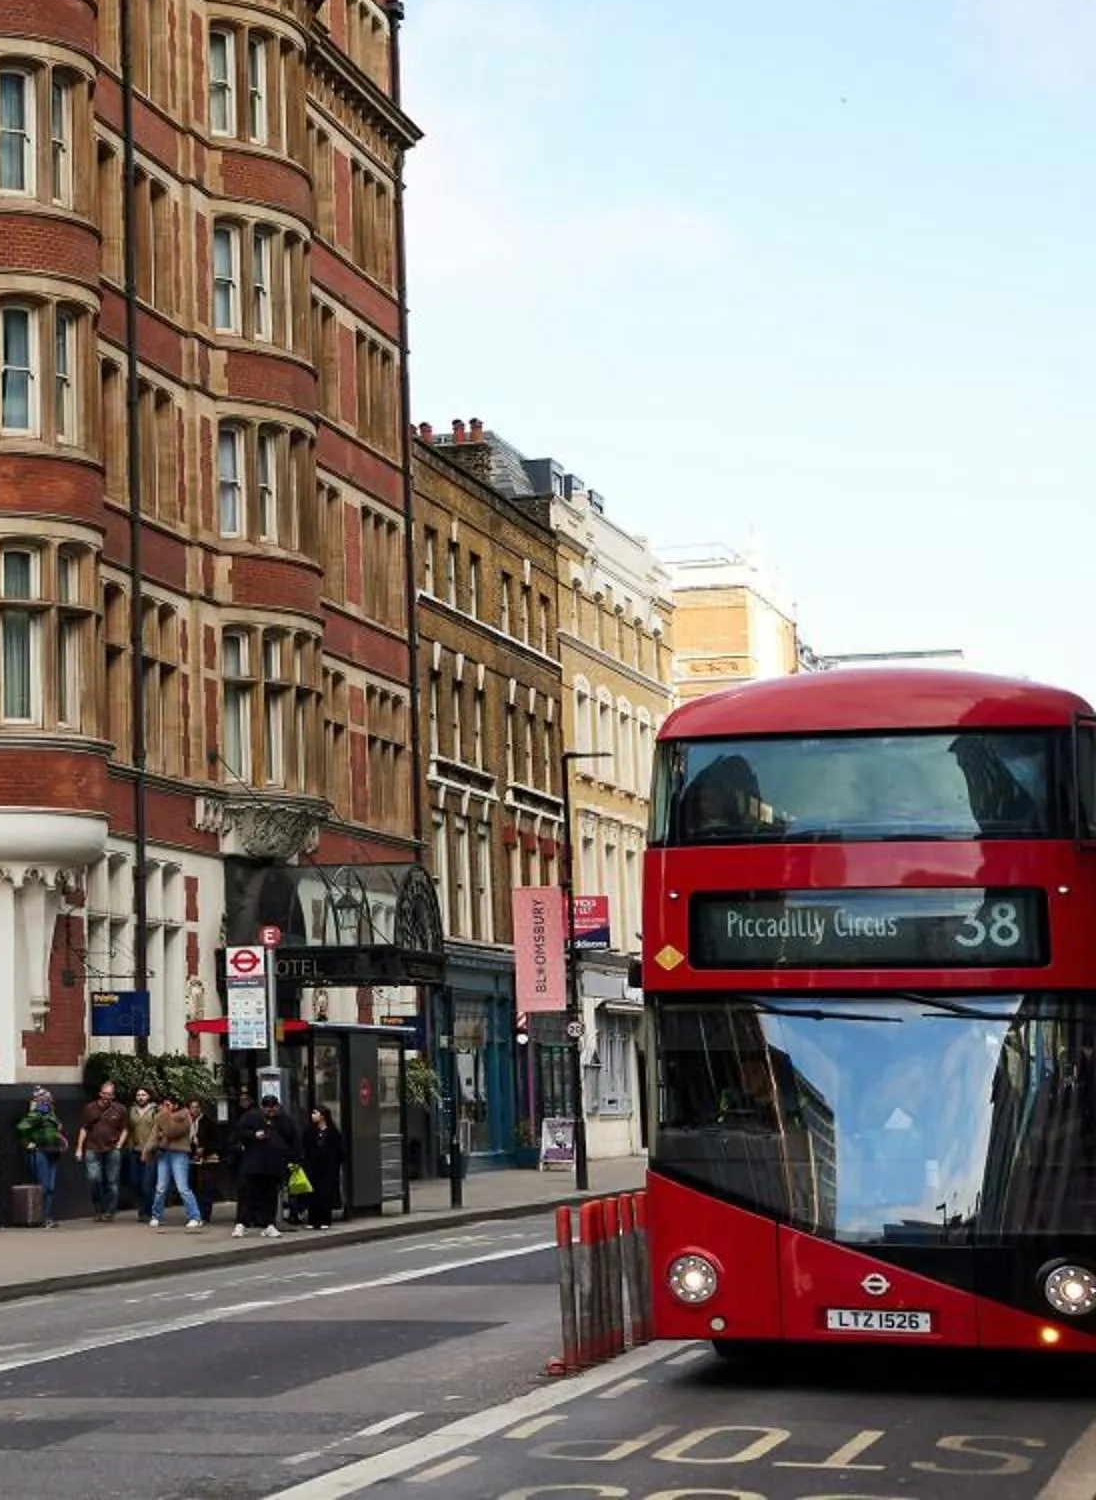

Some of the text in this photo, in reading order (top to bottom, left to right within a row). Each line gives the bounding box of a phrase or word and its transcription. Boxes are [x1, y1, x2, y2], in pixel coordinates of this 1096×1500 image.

[265, 928, 275, 943] E
[727, 908, 898, 944] Piccadilly Circus
[955, 902, 1021, 948] 38
[838, 1311, 919, 1329] LTZ 1526
[527, 1424, 1047, 1475] STOP
